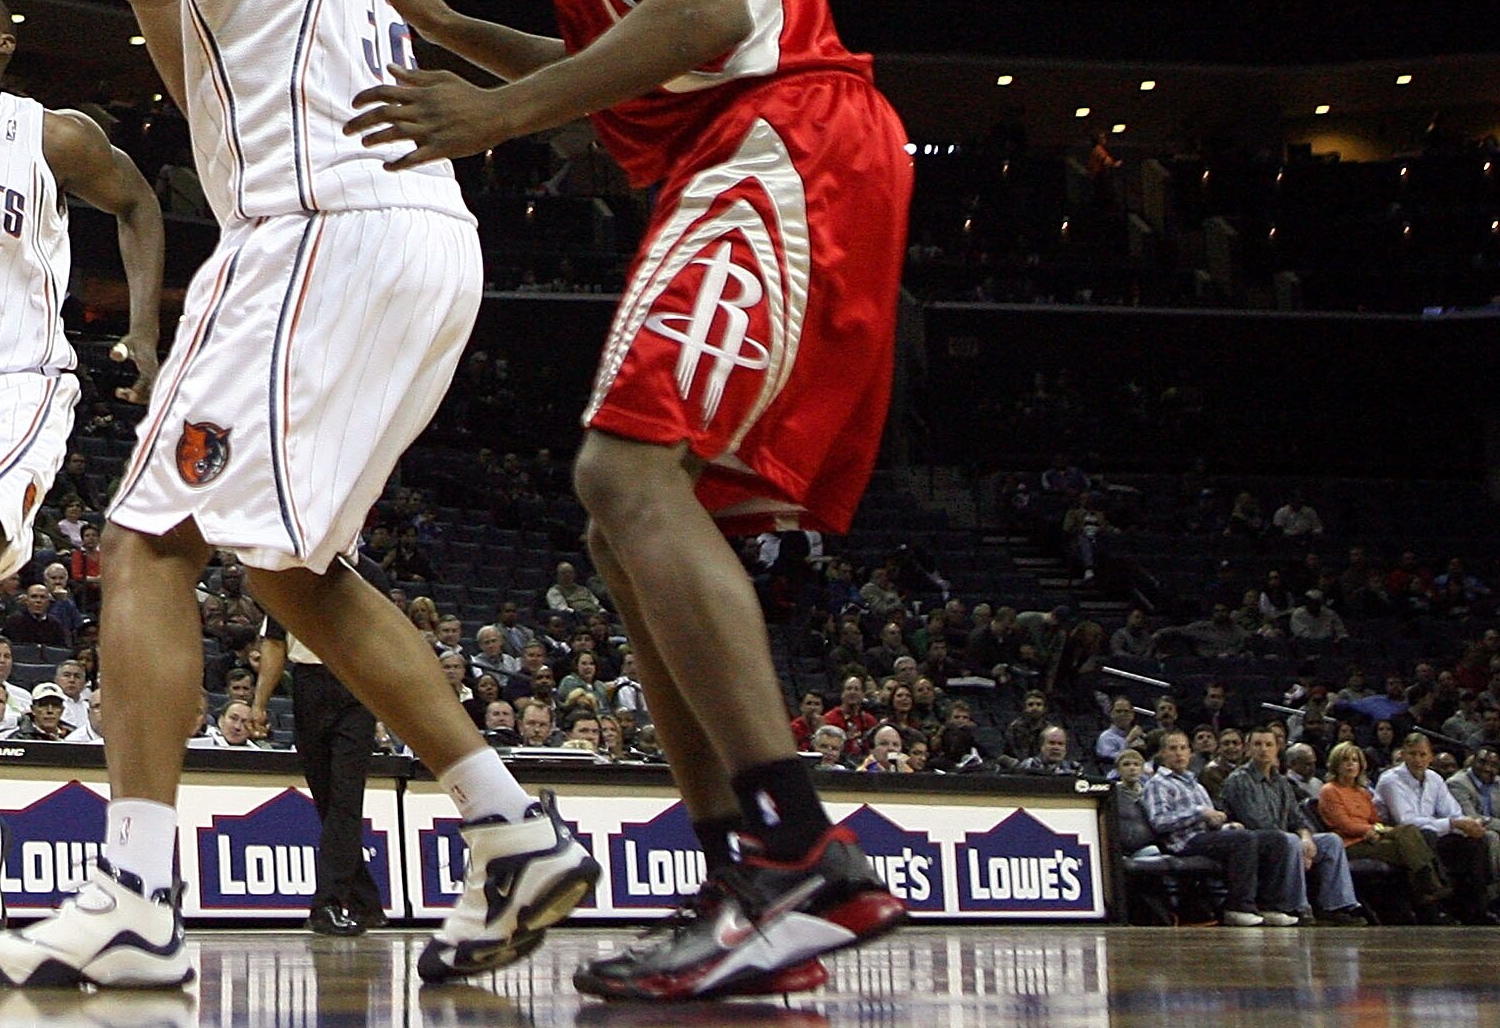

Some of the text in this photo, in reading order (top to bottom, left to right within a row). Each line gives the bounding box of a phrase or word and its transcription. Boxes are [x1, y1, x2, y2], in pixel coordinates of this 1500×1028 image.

[1, 841, 98, 893] LOW
[218, 834, 316, 895] LOW
[625, 839, 706, 896] LOW
[968, 848, 1082, 901] LOWE'S
